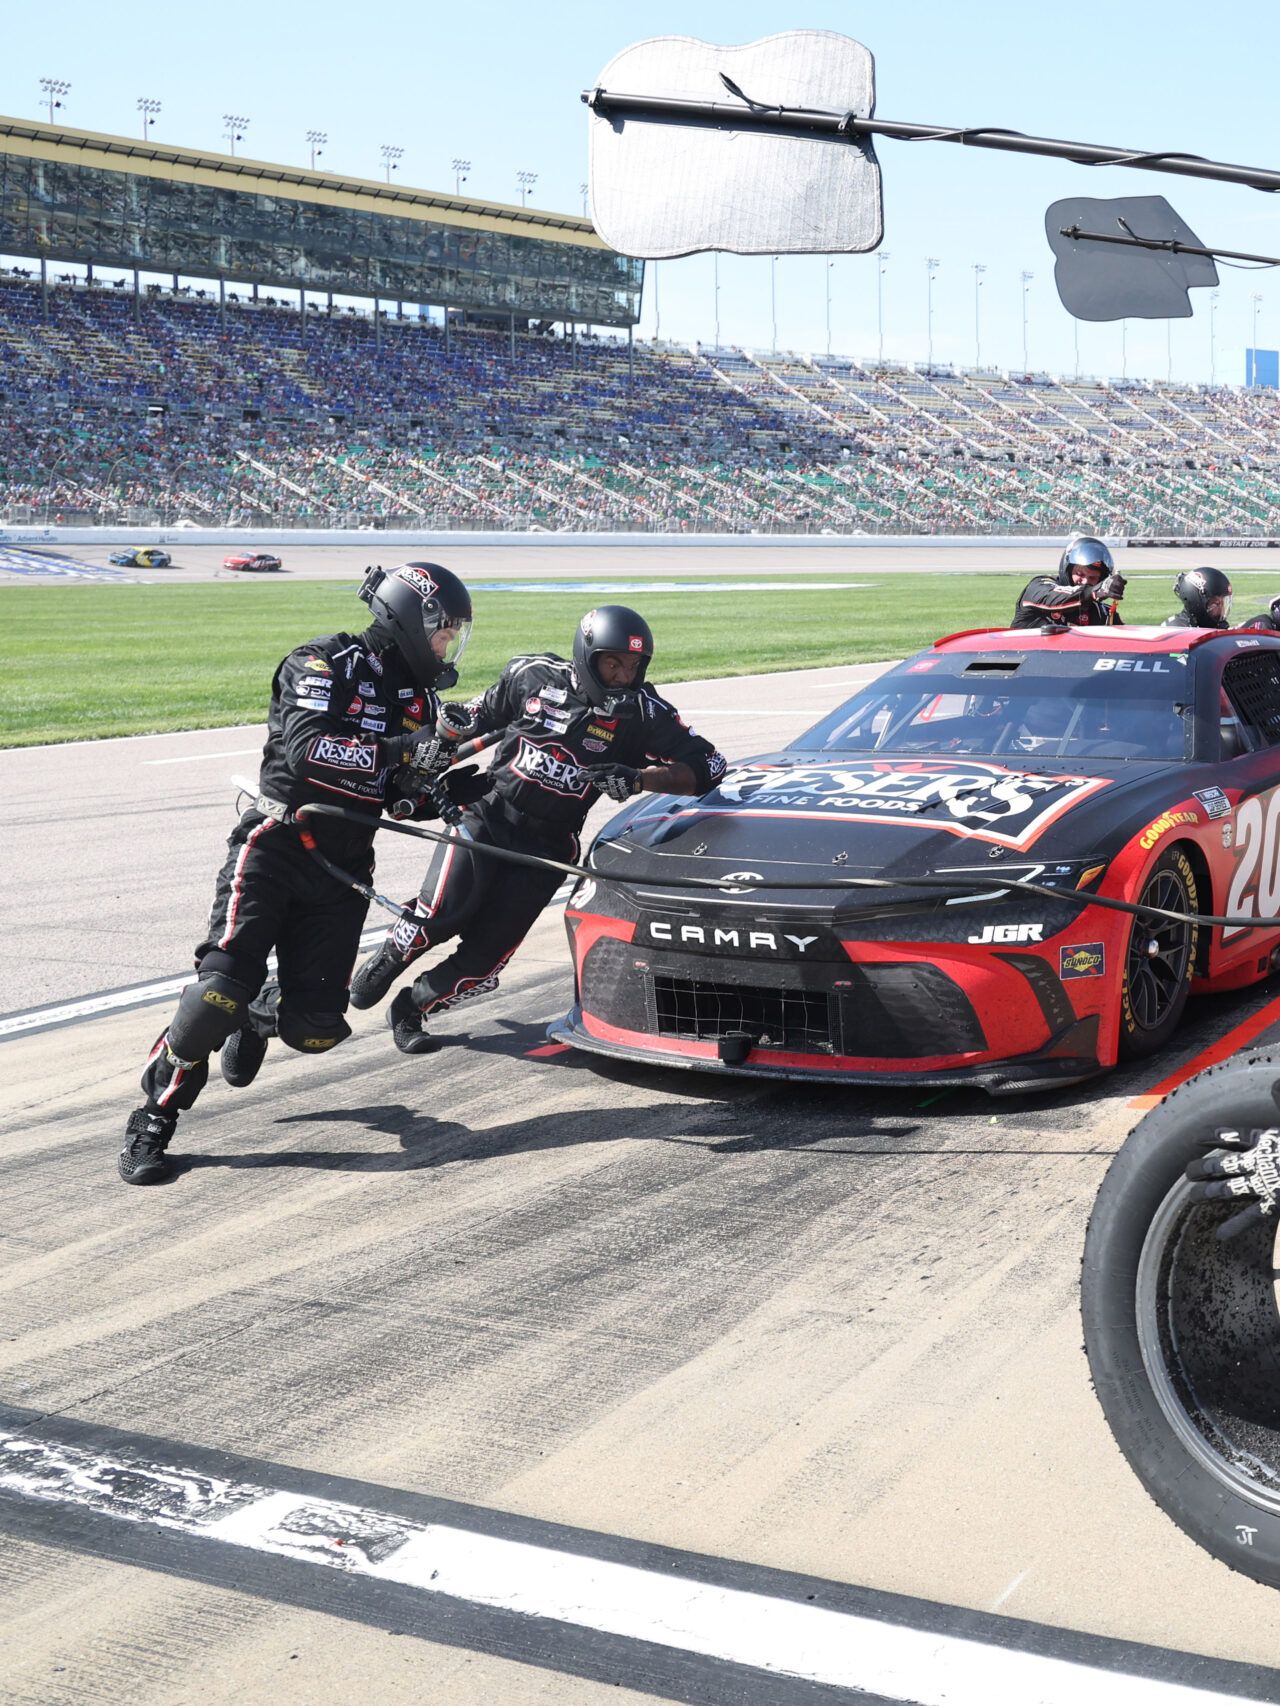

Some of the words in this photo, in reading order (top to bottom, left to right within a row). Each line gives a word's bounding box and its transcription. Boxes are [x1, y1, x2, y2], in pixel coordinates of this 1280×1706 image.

[1093, 658, 1170, 673] BELL
[747, 792, 820, 807] FINE
[817, 796, 922, 812] FOODS
[1139, 810, 1199, 851] GOODYEAR
[650, 921, 819, 953] CAMRY
[967, 923, 1044, 945] JGR
[1062, 955, 1101, 971] SUNOCO
[1121, 969, 1136, 1033] EAGLE
